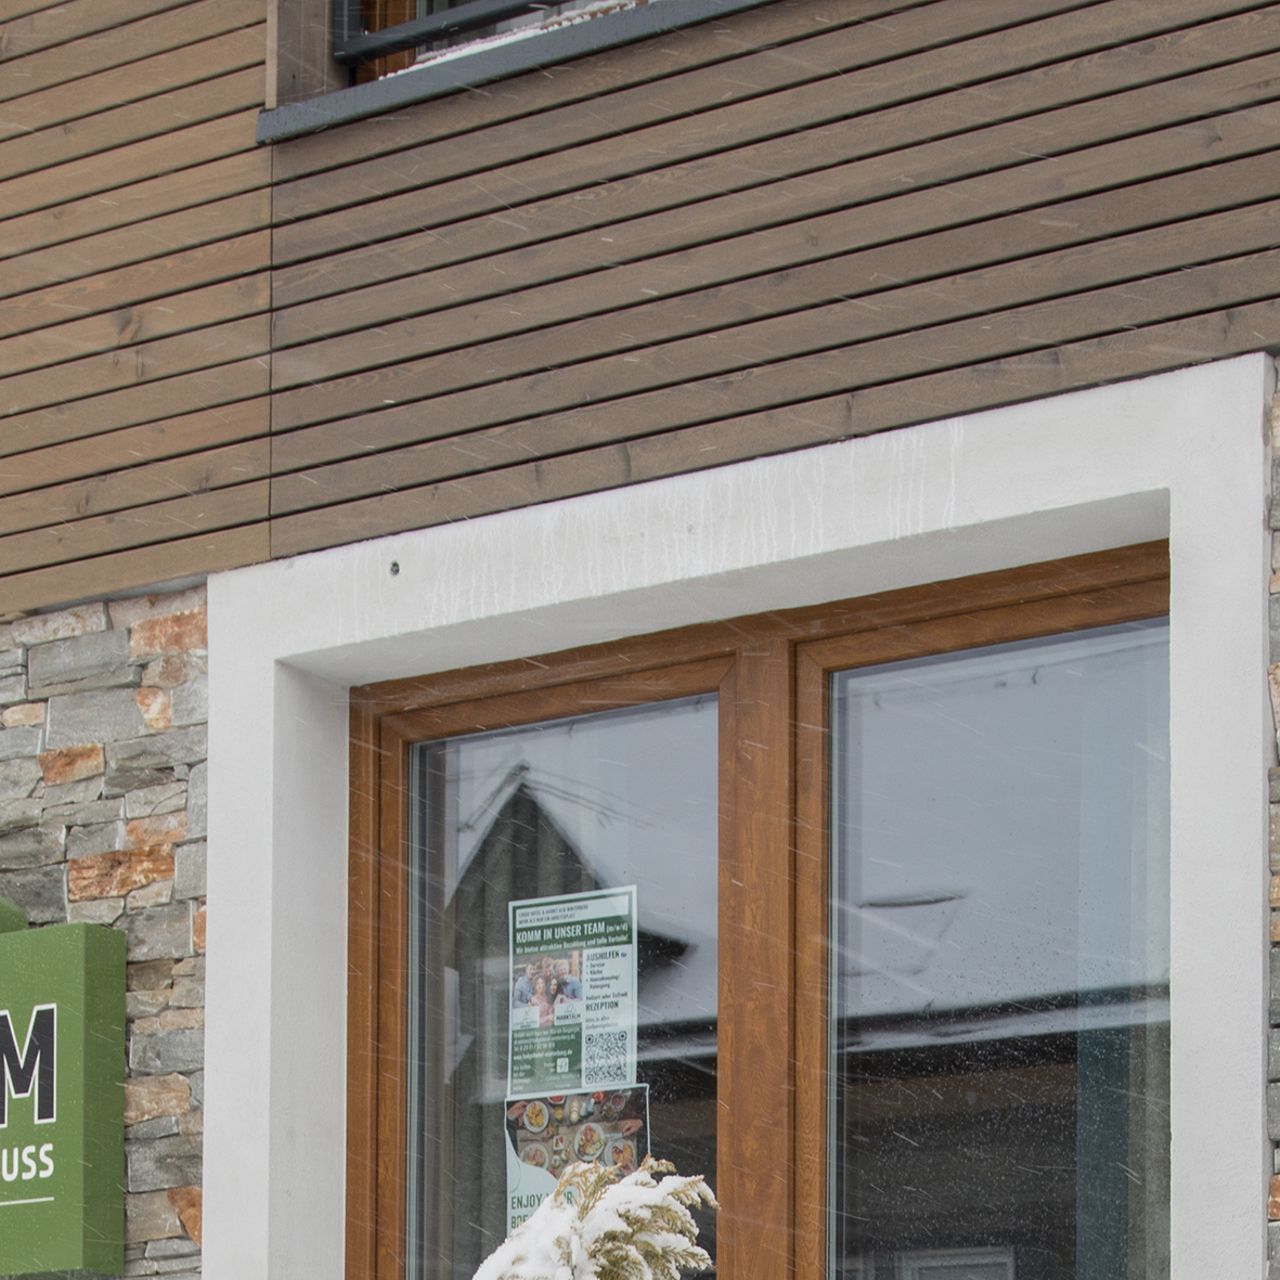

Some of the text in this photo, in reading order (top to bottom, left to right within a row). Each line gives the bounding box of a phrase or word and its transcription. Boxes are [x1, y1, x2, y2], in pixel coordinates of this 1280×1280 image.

[516, 930, 542, 944] KOMM
[543, 928, 552, 940] IN
[554, 924, 581, 940] UNSER
[584, 921, 606, 935] TEAM
[586, 950, 620, 962] AUSHILFEN
[586, 1001, 619, 1012] REZEPTION
[511, 1193, 542, 1210] ENJOY
